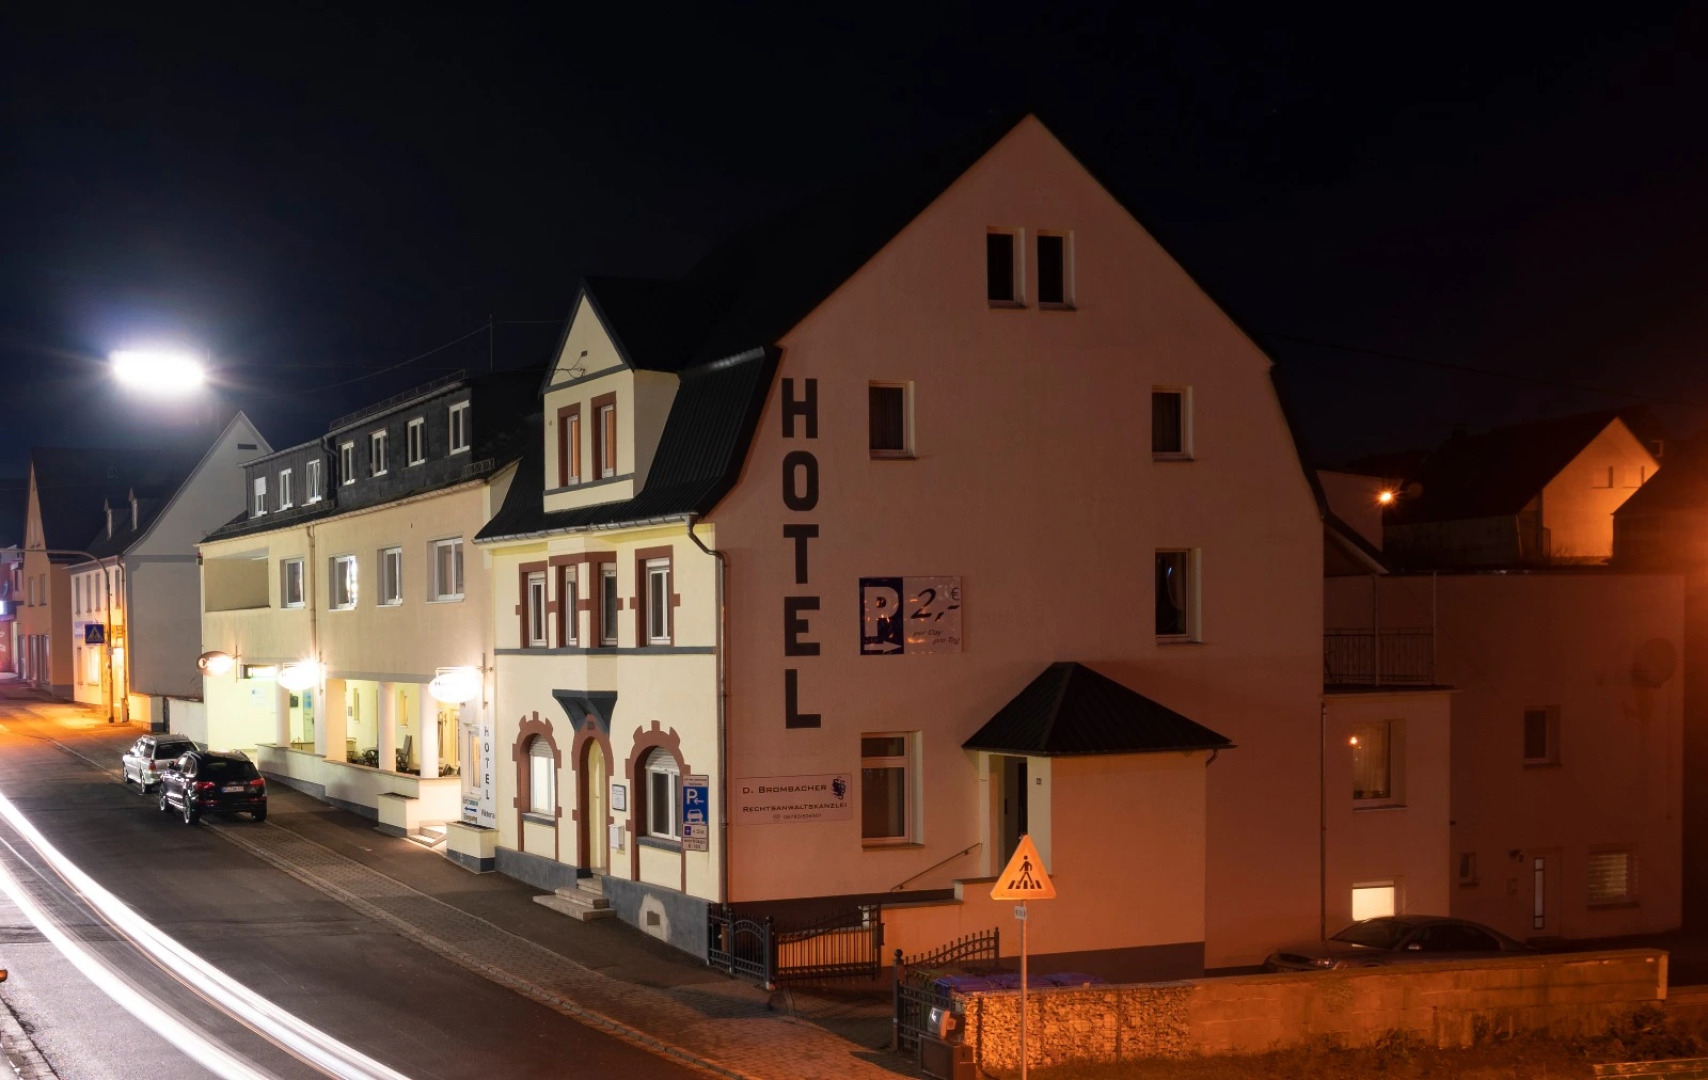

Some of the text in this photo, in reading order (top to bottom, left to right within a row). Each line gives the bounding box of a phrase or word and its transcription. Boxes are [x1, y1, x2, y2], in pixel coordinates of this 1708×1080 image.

[781, 378, 821, 729] HOTEL
[864, 586, 899, 637] P
[928, 629, 943, 637] Day
[948, 636, 960, 645] Tag
[758, 784, 827, 794] BROMBACHER
[686, 788, 698, 805] P
[742, 802, 847, 813] RECHTSANWALTSKANZLEI
